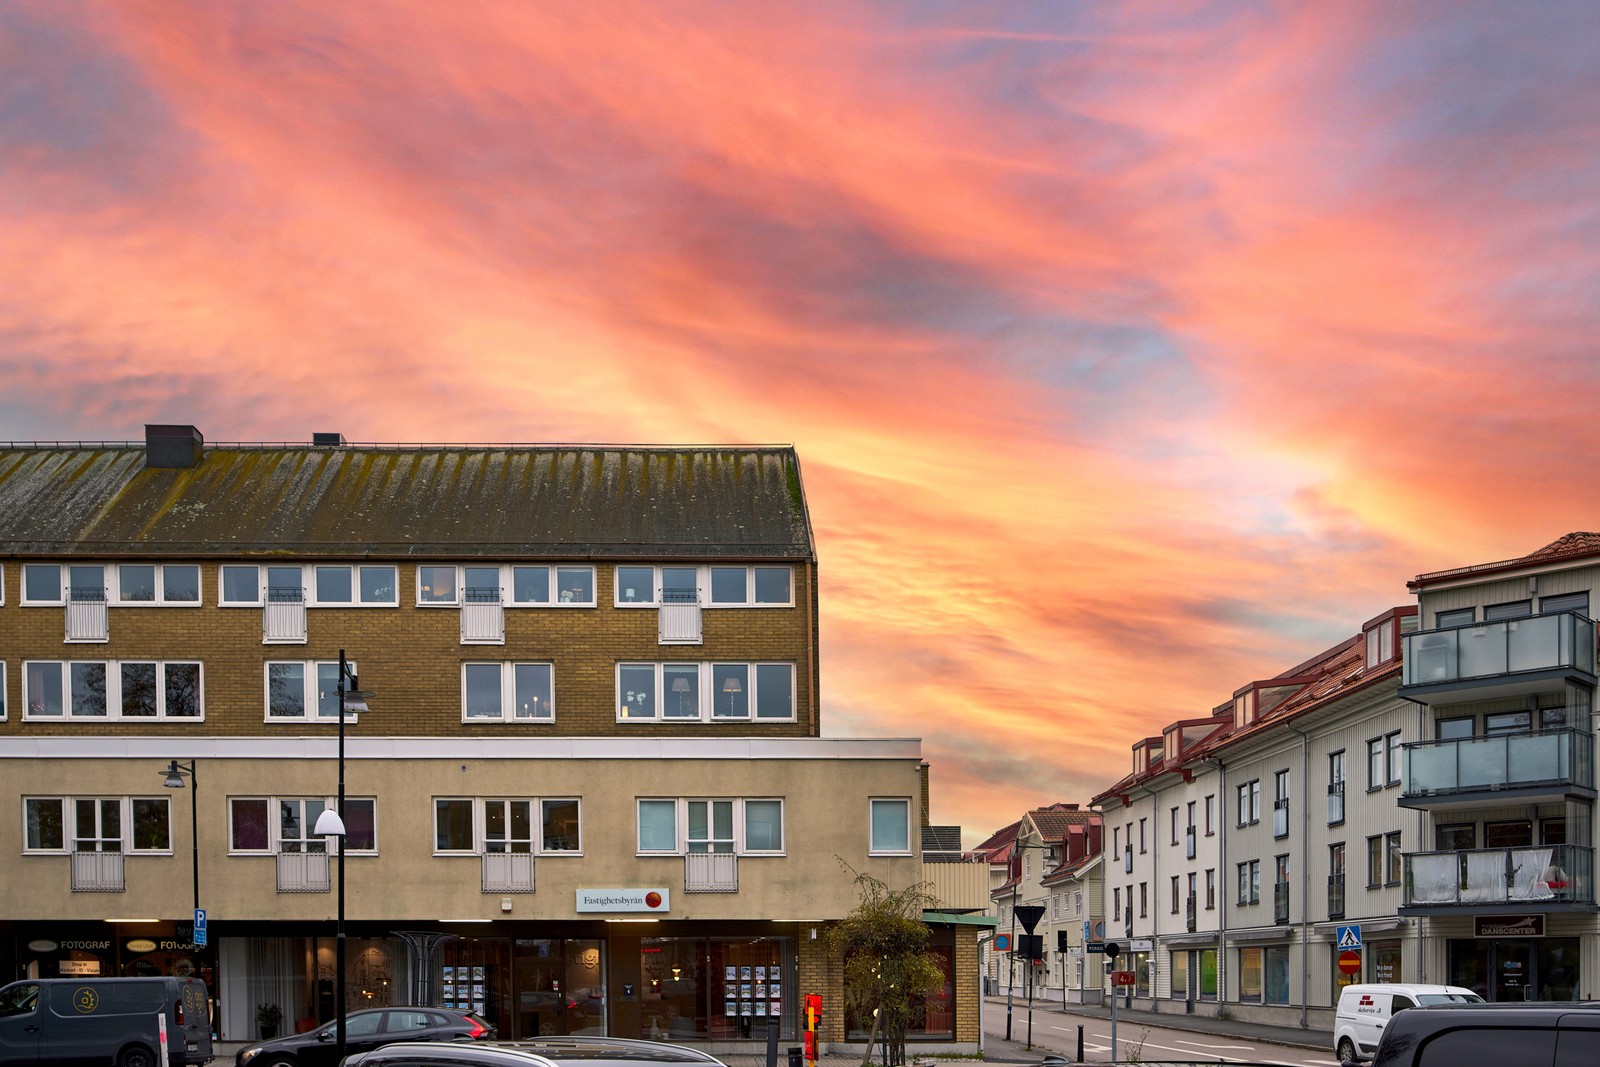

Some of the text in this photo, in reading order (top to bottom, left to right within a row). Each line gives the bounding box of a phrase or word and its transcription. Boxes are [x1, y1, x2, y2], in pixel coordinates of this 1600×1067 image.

[584, 896, 642, 906] Fastighetsbyrån
[197, 911, 205, 927] P
[61, 941, 111, 949] FOTOGRAF
